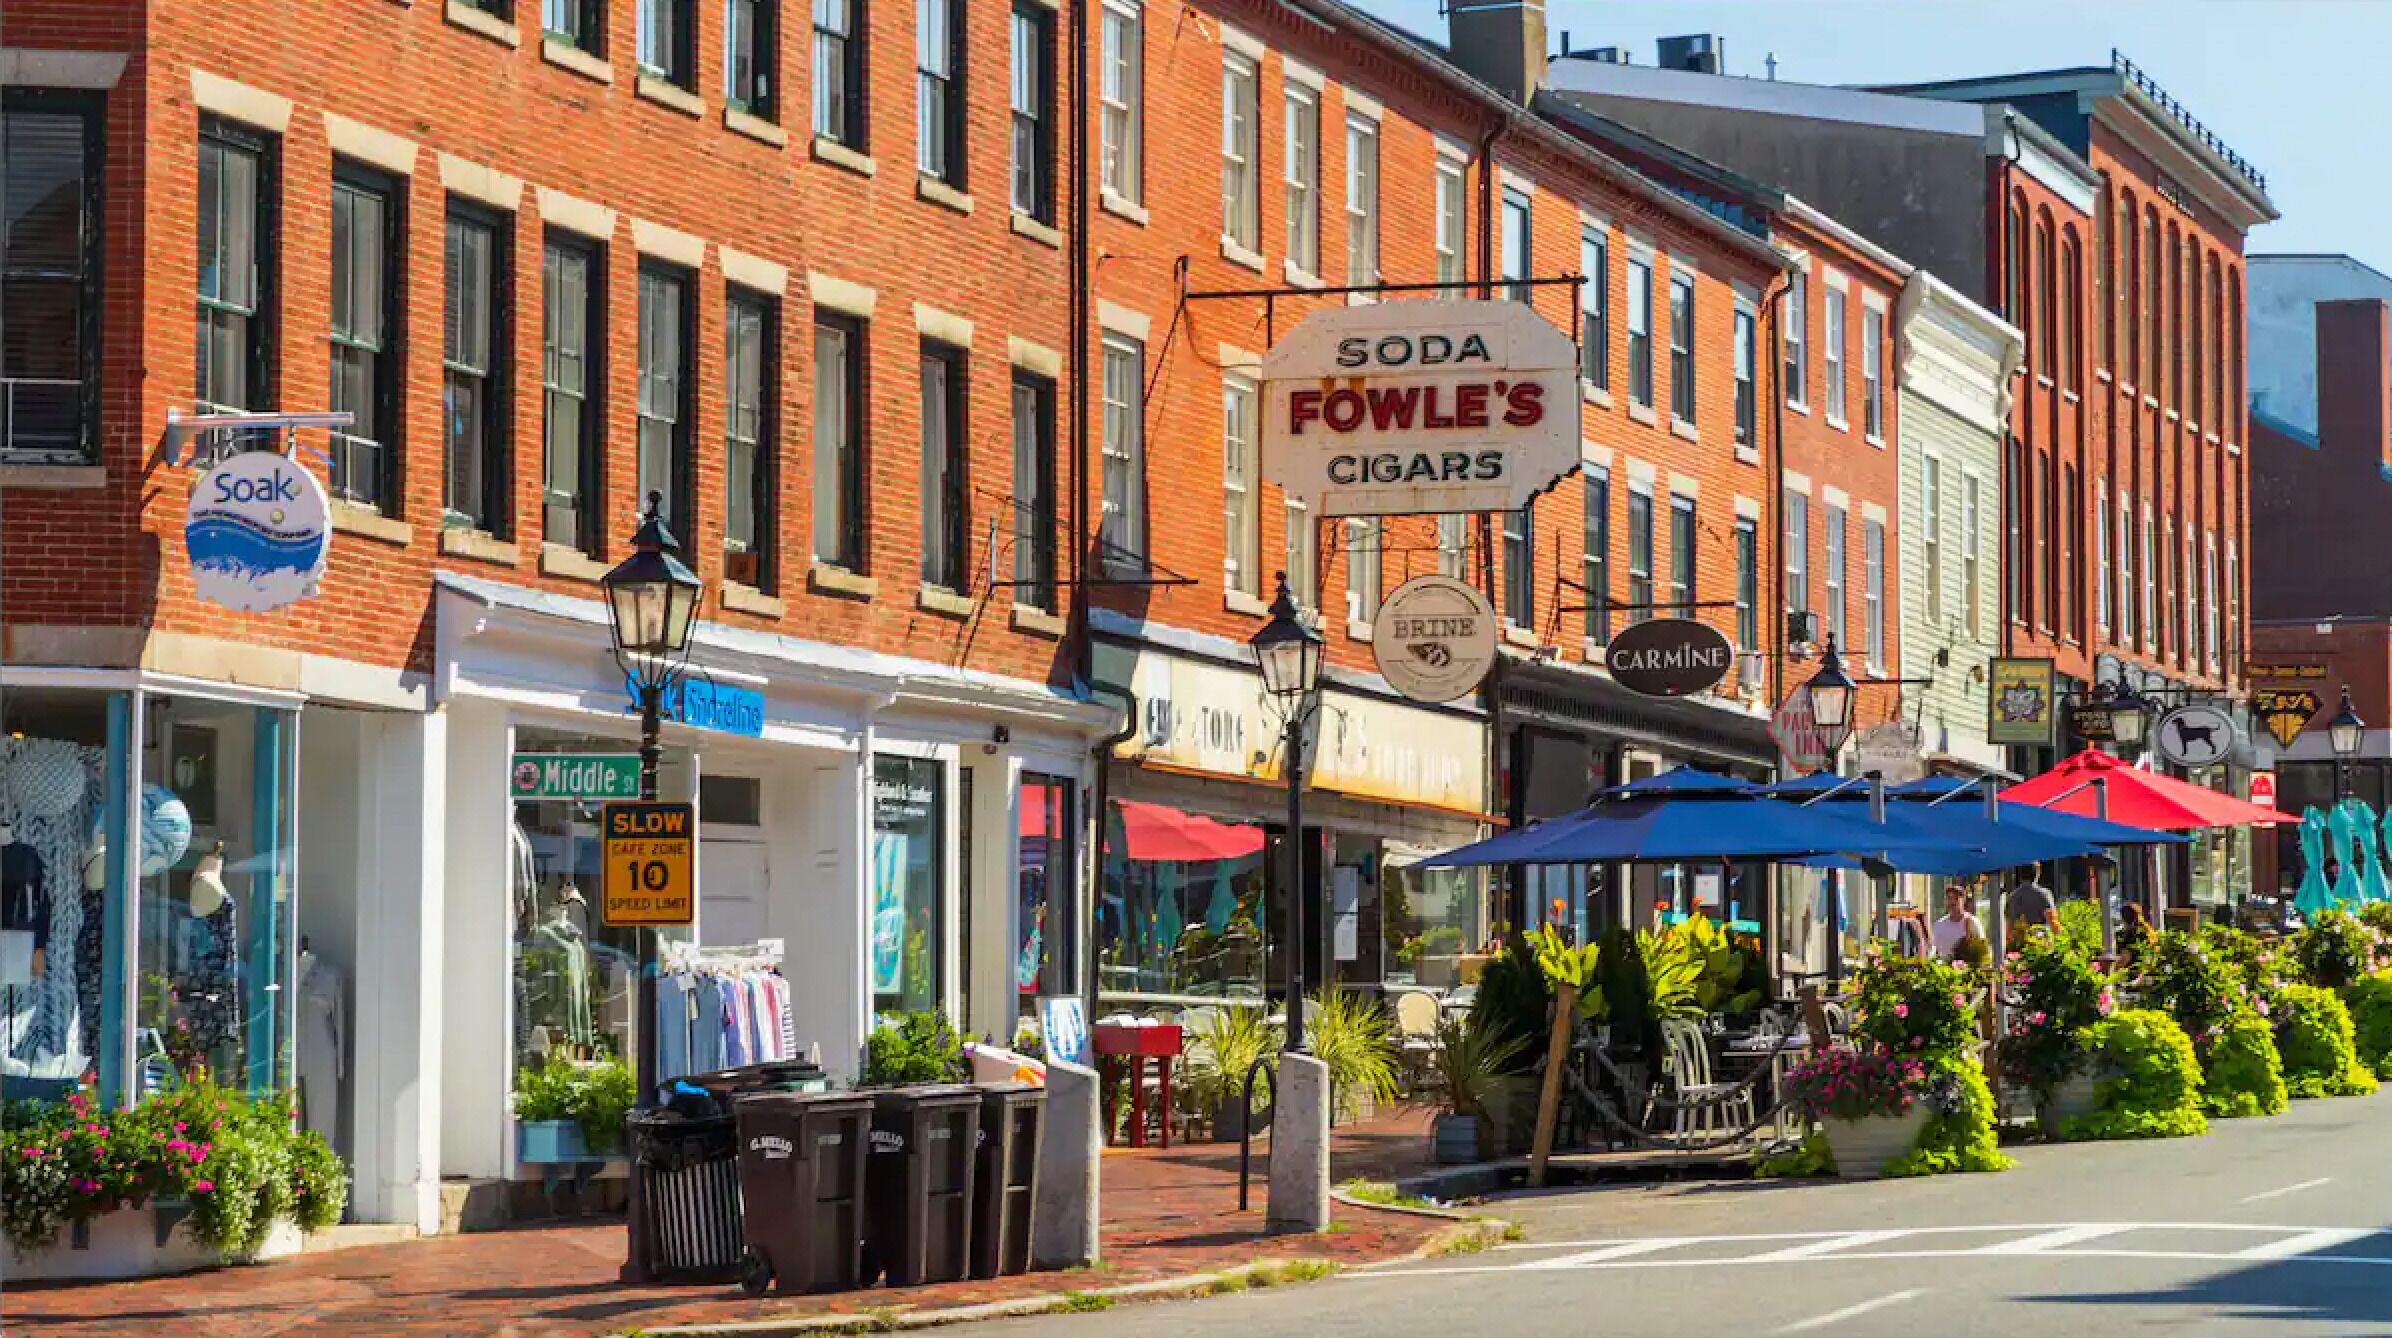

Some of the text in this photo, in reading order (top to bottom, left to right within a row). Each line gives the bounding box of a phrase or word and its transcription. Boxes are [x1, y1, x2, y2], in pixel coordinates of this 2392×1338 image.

[1336, 334, 1490, 367] SODA
[1289, 380, 1545, 434] FOWLE'S
[1327, 451, 1503, 484] CIGARS
[214, 468, 295, 504] Soak
[1392, 617, 1476, 638] BRINE
[1613, 641, 1725, 670] CARMINE
[543, 760, 617, 793] Middle
[613, 811, 685, 833] SLOW
[651, 842, 686, 855] ZONE
[628, 861, 669, 891] 10
[610, 897, 687, 911] SPEED LIMIT
